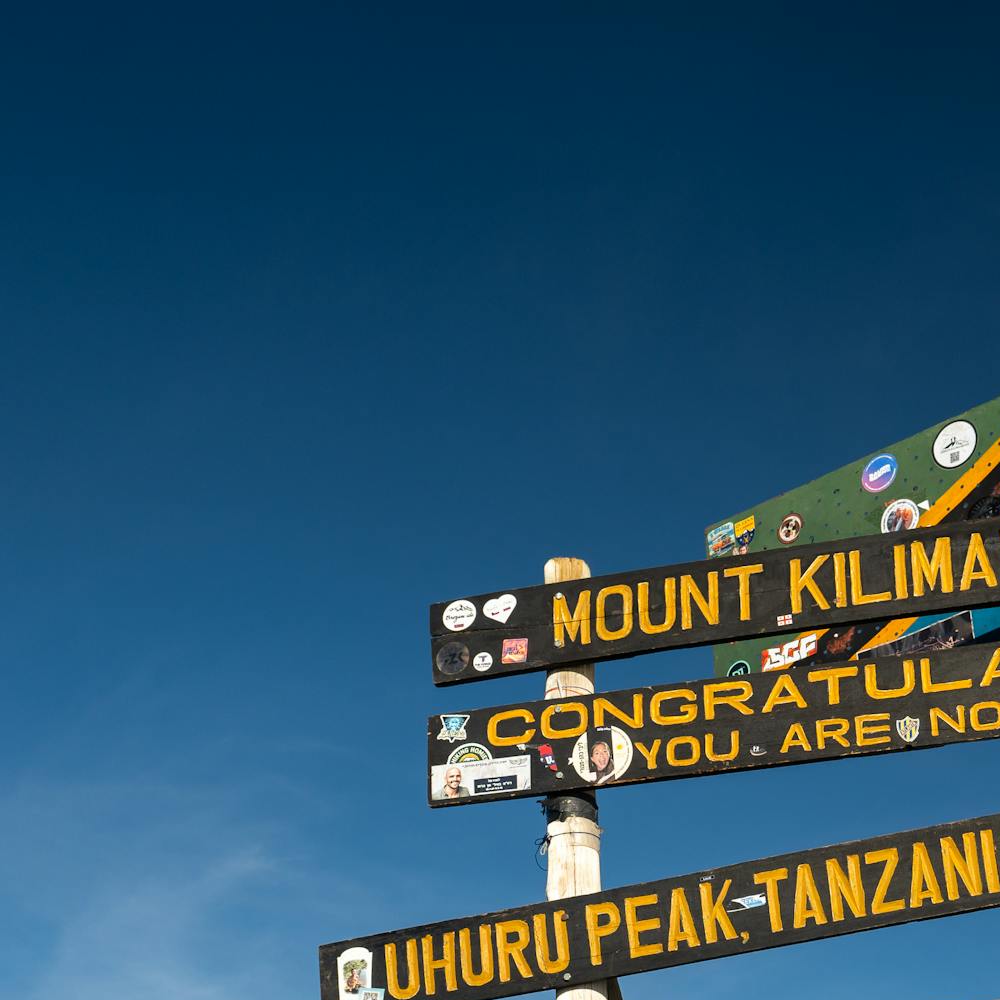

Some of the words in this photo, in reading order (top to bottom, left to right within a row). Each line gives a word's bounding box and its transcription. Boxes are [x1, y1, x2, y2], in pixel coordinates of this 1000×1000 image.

[553, 563, 763, 647] MOUNT
[635, 730, 740, 770] YOU
[780, 713, 891, 753] ARE
[384, 910, 570, 1000] UHURU
[585, 880, 751, 966] PEAK,
